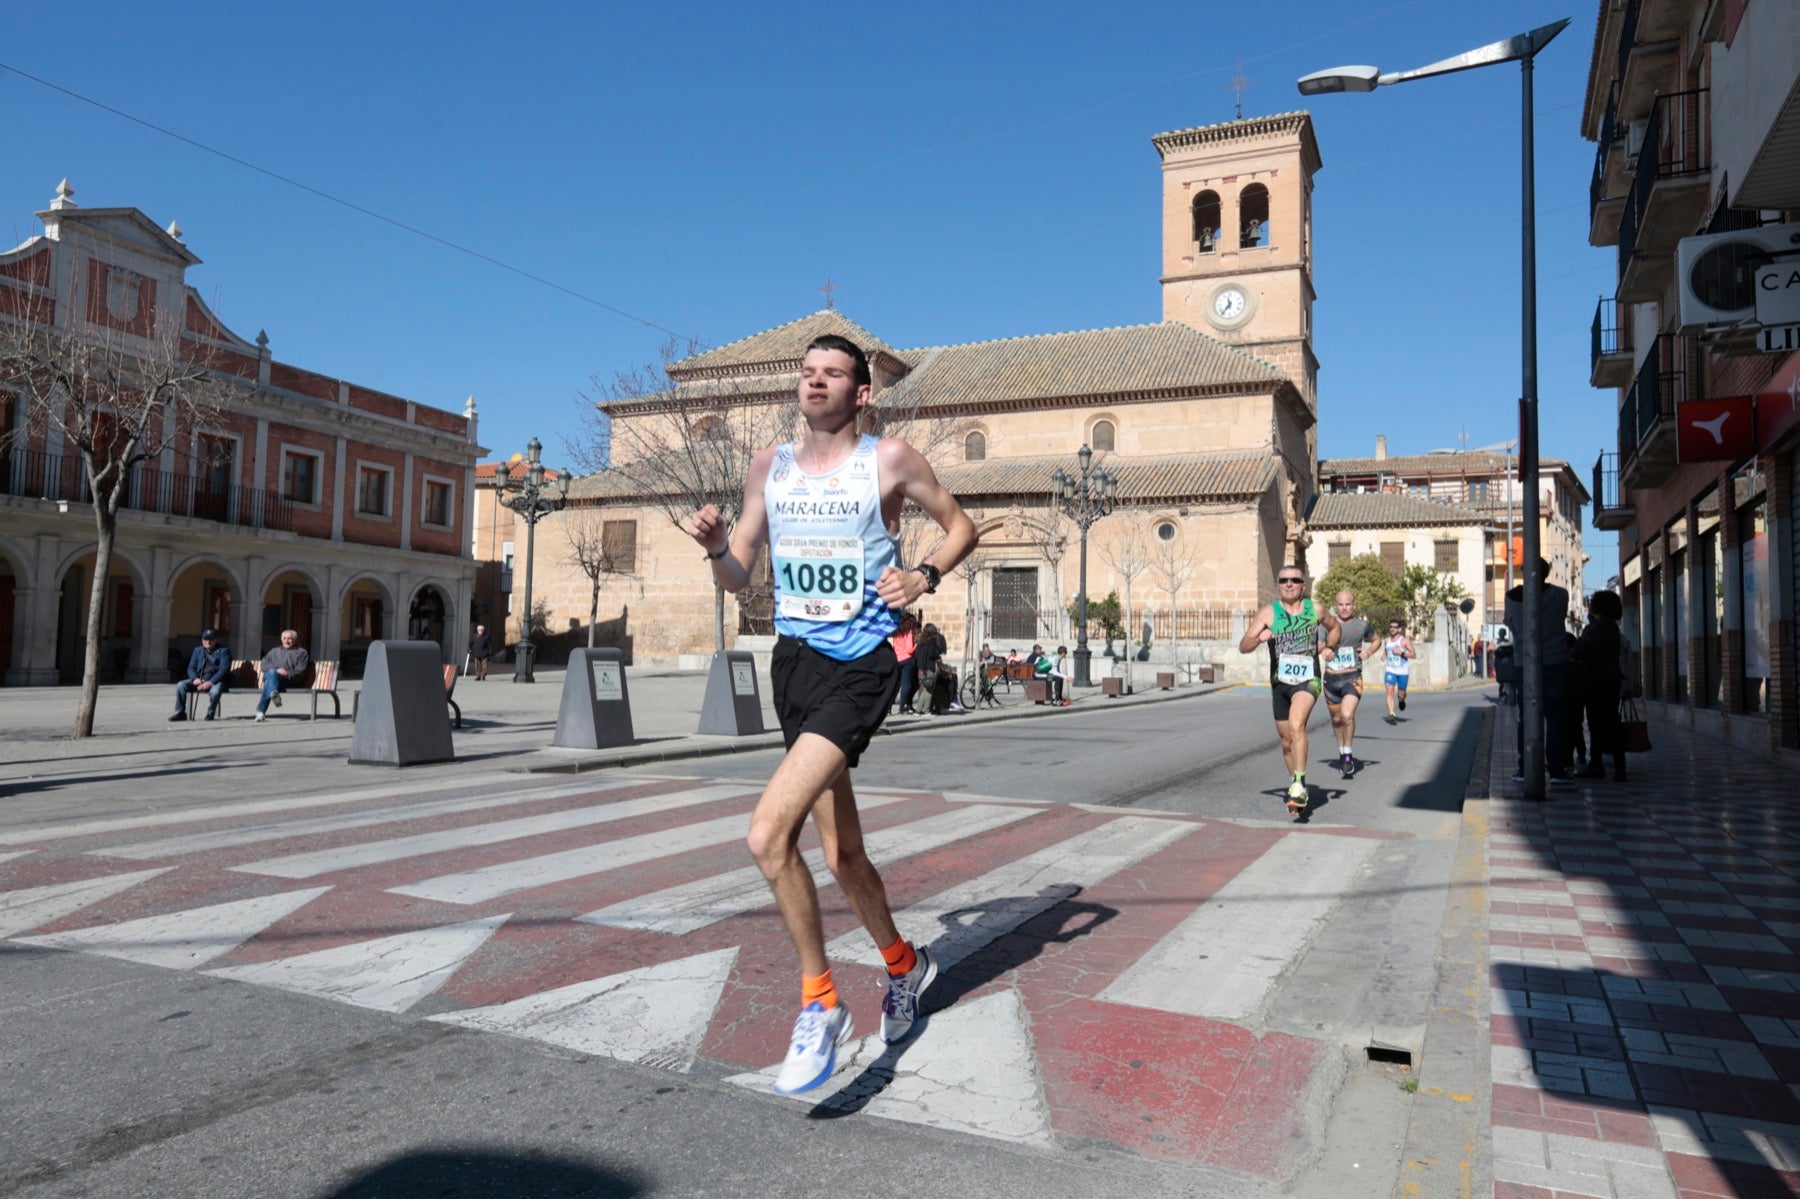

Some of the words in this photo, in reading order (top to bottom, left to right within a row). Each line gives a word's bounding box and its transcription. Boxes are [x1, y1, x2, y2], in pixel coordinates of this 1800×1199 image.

[775, 501, 860, 515] MARACENA
[783, 562, 858, 594] 1088
[1284, 664, 1308, 676] 207
